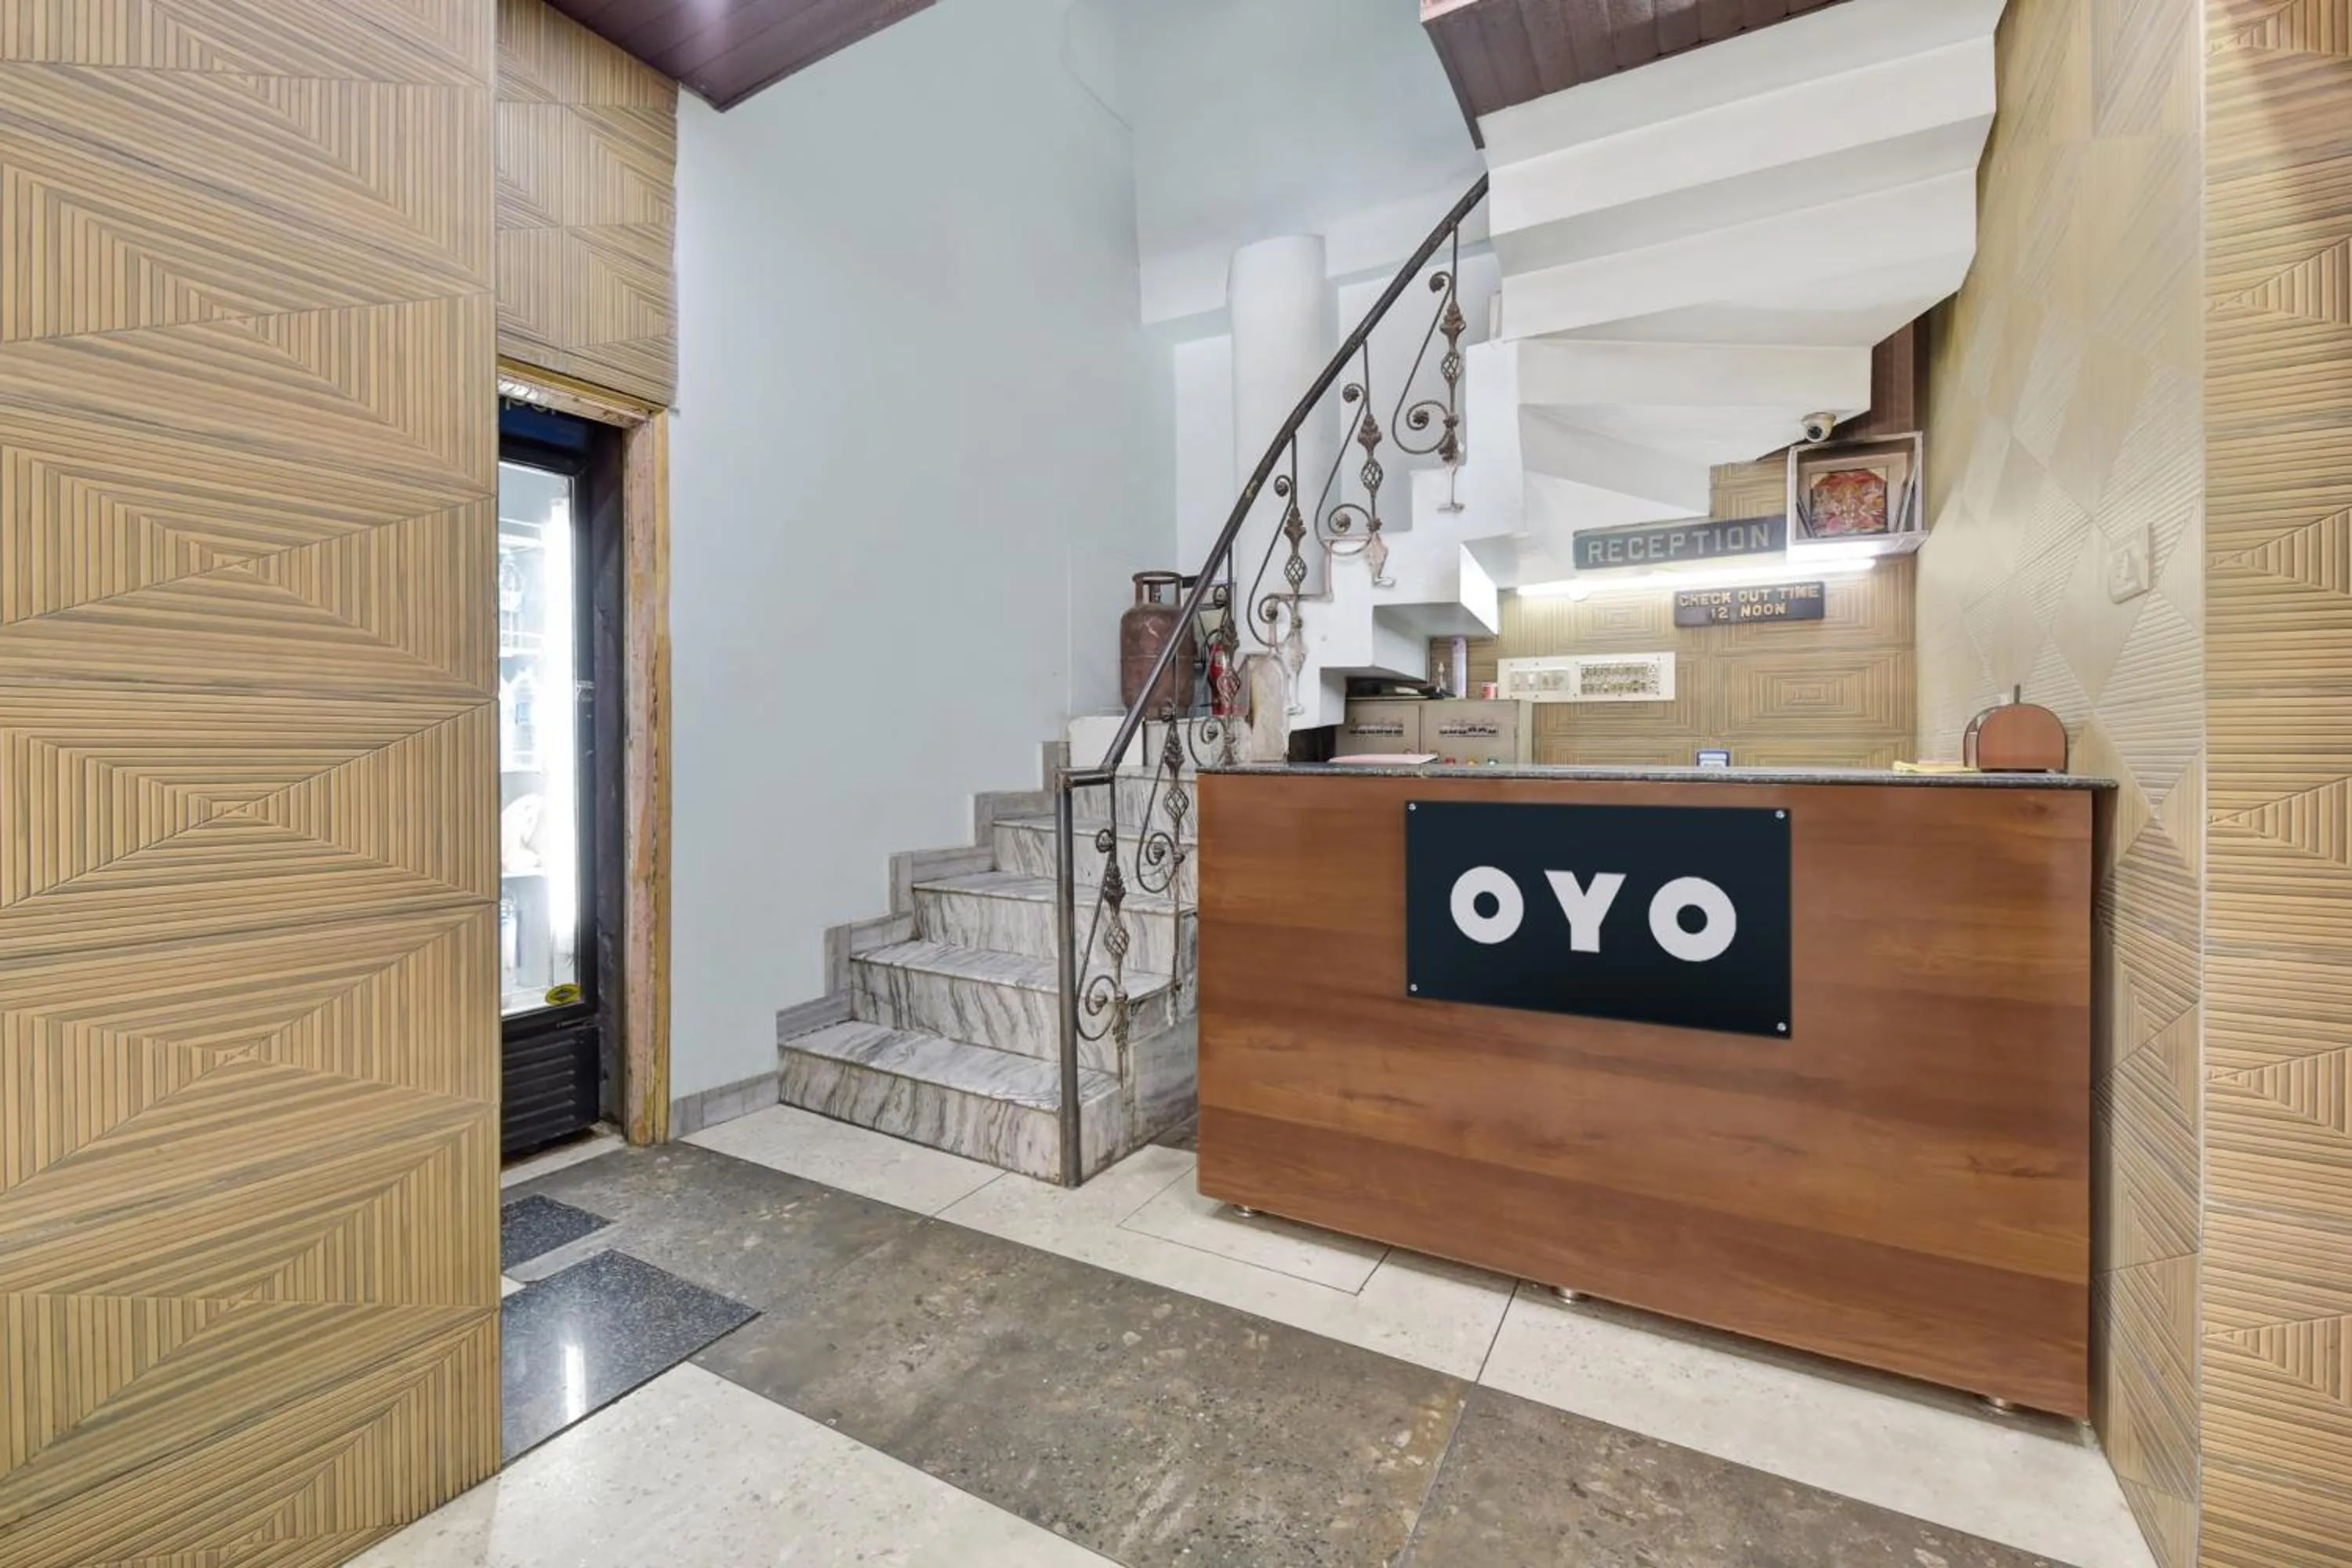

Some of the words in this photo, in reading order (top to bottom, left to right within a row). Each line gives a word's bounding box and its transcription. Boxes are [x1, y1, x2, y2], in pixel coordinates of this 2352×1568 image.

[1588, 524, 1769, 564] RECEPTION
[1679, 591, 1732, 607] CHECK
[1737, 588, 1771, 603] OUT
[1777, 585, 1820, 600] TIME
[1710, 607, 1730, 619] 12
[1740, 602, 1787, 618] NOON
[1450, 866, 1737, 962] OYO
